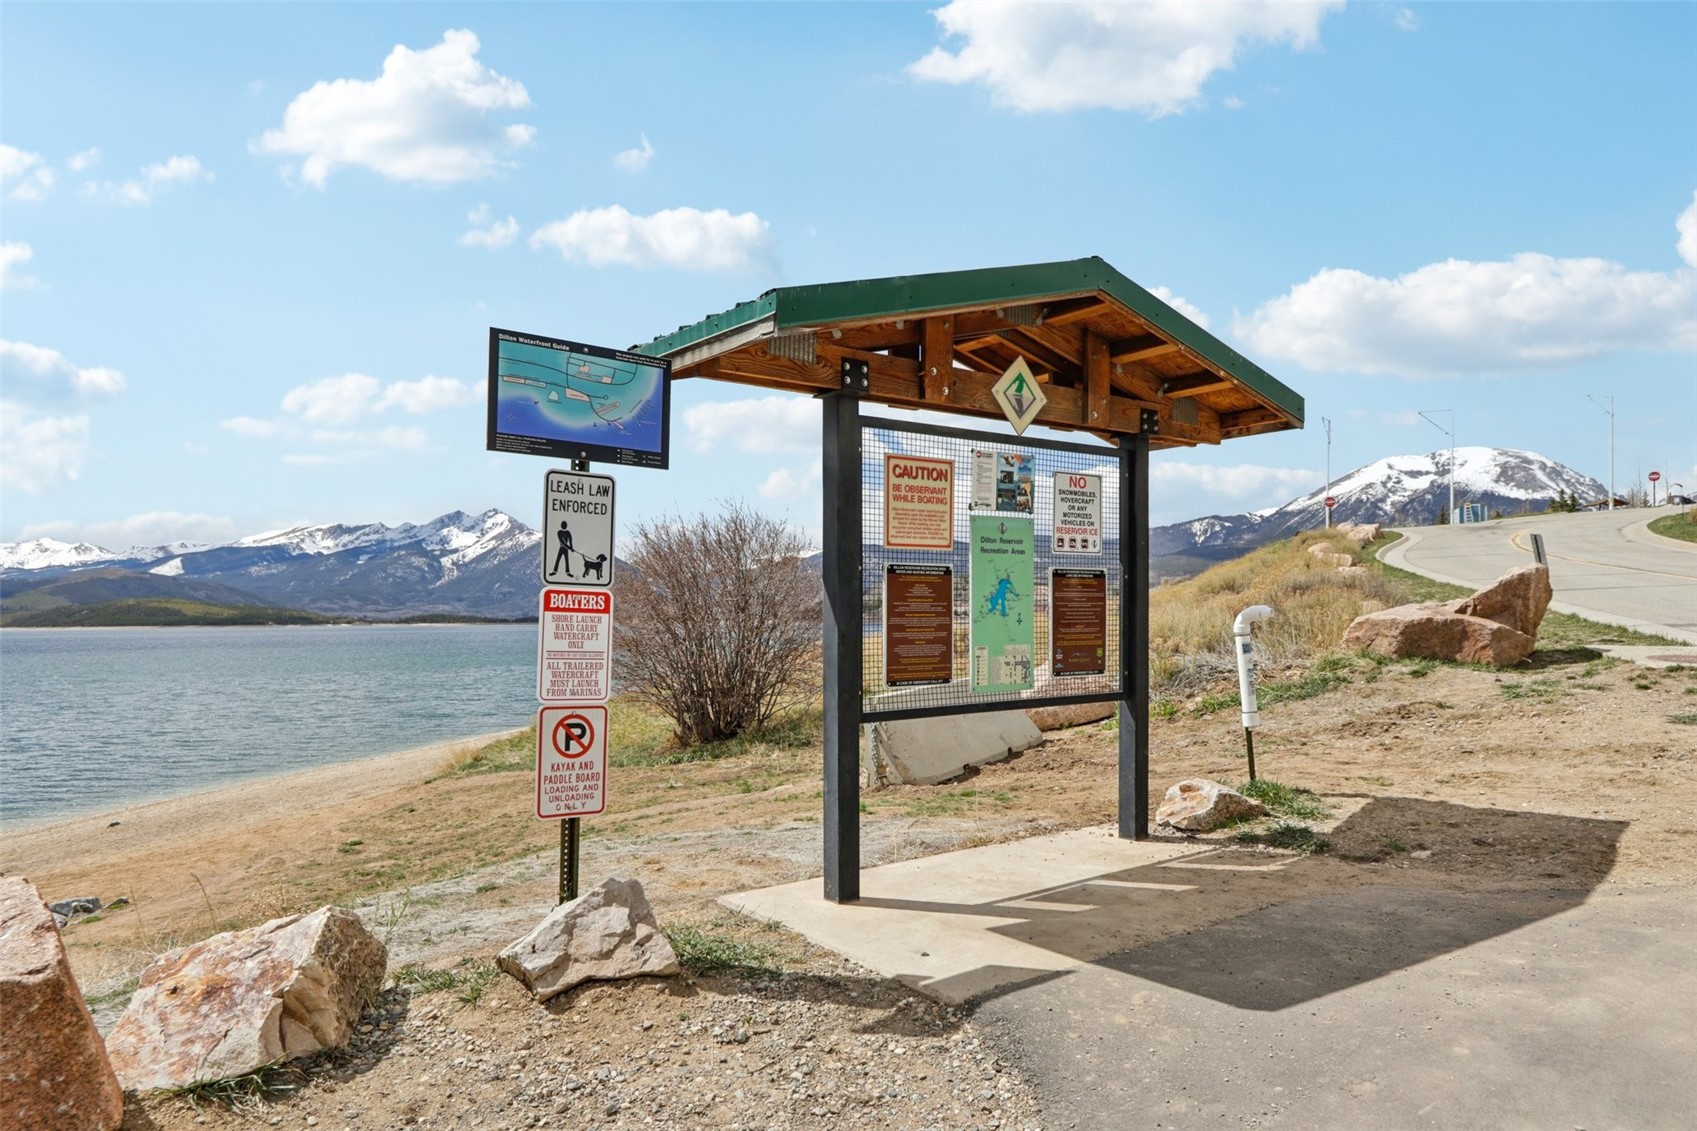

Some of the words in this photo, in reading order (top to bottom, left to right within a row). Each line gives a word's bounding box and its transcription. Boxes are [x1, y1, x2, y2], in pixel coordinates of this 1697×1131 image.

[519, 337, 551, 347] Waterfront
[892, 464, 948, 482] CAUTION
[1069, 476, 1086, 489] NO
[551, 480, 584, 495] LEASH
[589, 484, 610, 497] LAW
[905, 484, 947, 495] OBSERVANT
[892, 494, 915, 502] WHILE
[918, 496, 947, 505] BOATING
[552, 499, 607, 515] ENFORCED
[1056, 527, 1088, 535] RESERVOIR
[550, 594, 605, 610] BOATERS
[552, 614, 573, 623] SHORE
[576, 616, 602, 624] LAUNCH
[576, 624, 598, 632] CARRY
[554, 632, 599, 640] WATERCRAFT
[563, 662, 603, 670] TRAILERED
[551, 671, 599, 679] WATERCRAFT
[569, 688, 601, 696] MARINAS
[551, 762, 576, 772] KAYAK
[579, 761, 594, 770] AND
[544, 774, 572, 785] PADDLE
[576, 772, 600, 783] BOARD
[545, 785, 579, 794] LOADING
[549, 793, 594, 803] UNLOADING
